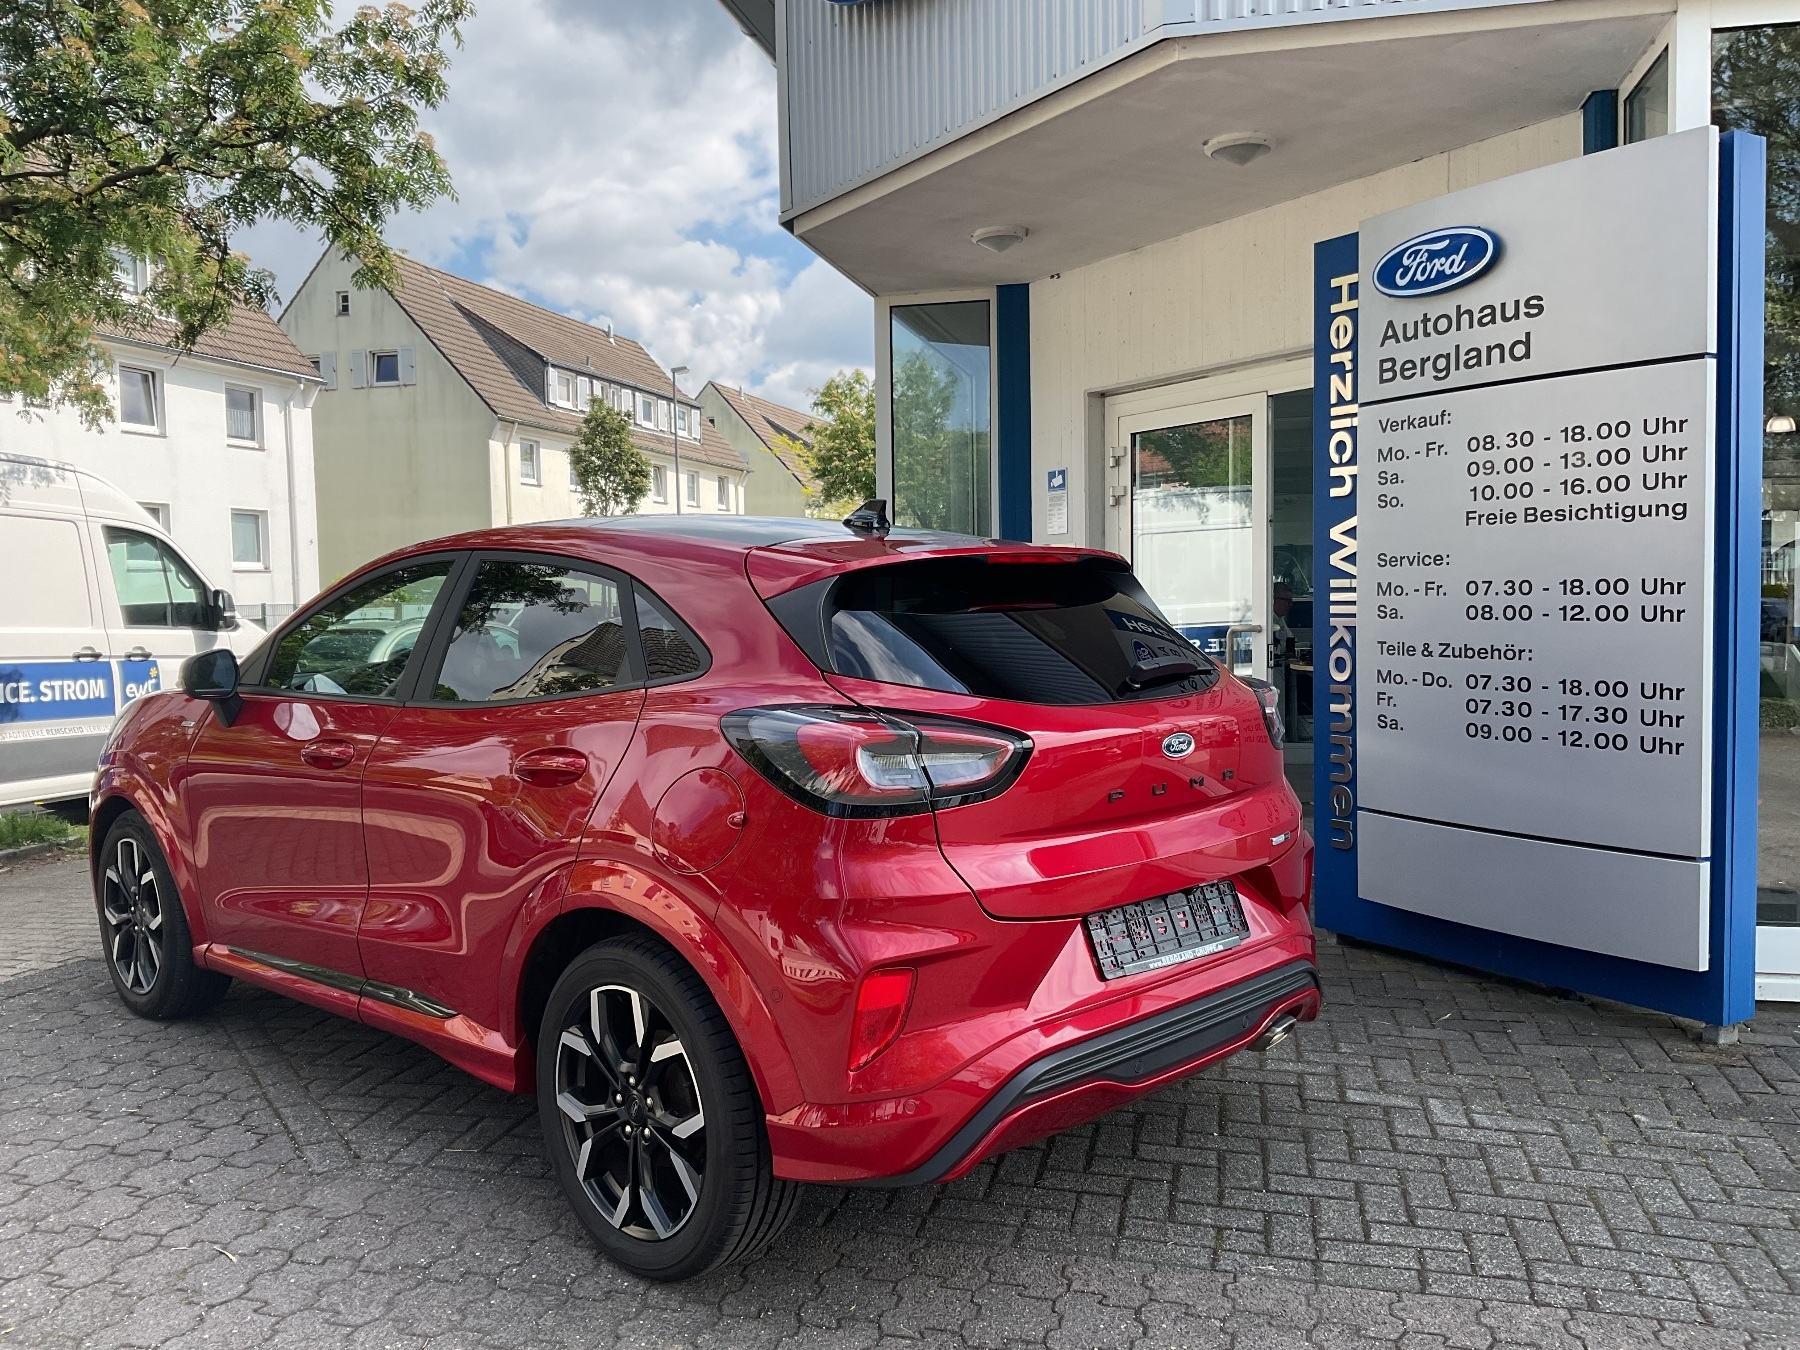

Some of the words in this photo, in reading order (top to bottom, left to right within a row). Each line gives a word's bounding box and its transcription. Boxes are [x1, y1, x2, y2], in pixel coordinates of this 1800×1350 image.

[1395, 236, 1469, 286] Ford
[1379, 295, 1545, 348] Autohaus
[1379, 331, 1532, 384] Bergland
[1329, 273, 1358, 497] Herzlich
[1379, 410, 1451, 433] Verkauf:
[1378, 447, 1409, 463] Mo.
[1426, 441, 1447, 457] Fr.
[1467, 431, 1534, 452] 08.30
[1560, 421, 1631, 443] 18.00
[1643, 417, 1688, 435] Uhr
[1378, 471, 1404, 485] Sa.
[1467, 456, 1533, 477] 09.00
[1560, 448, 1630, 469] 13.00
[1643, 445, 1688, 463] Uhr
[1378, 494, 1403, 508] So.
[1470, 482, 1533, 501] 10.00
[1560, 475, 1630, 495] 16.00
[1643, 472, 1687, 490] Uhr
[1466, 509, 1517, 526] Freie
[1524, 502, 1687, 523] Besichtigung
[1377, 552, 1449, 567] Service:
[1377, 582, 1408, 596] Mo.
[1425, 581, 1446, 596] Fr.
[1466, 580, 1532, 596] 07.30
[1559, 578, 1629, 595] 18.00
[1641, 578, 1686, 595] Uhr
[1377, 605, 1403, 619] Sa.
[1466, 605, 1532, 621] 08.00
[1559, 605, 1628, 622] 12.00
[1641, 605, 1685, 622] Uhr
[1377, 641, 1416, 656] Teile
[1421, 643, 1434, 657] &
[1438, 643, 1532, 661] Zubehör:
[39, 679, 105, 703] STROM
[1328, 515, 1357, 849] Willkommen
[1377, 669, 1407, 685] Mo.
[1423, 672, 1452, 688] Do.
[1466, 674, 1531, 692] 07.30
[1558, 679, 1628, 698] 18.00
[1641, 682, 1685, 700] Uhr
[1377, 692, 1396, 707] Fr.
[1466, 698, 1532, 718] 07.30
[1558, 705, 1627, 724] 17.30
[1641, 709, 1685, 728] Uhr
[1378, 714, 1403, 731] Sa.
[1466, 723, 1532, 743] 09.00
[1558, 730, 1628, 751] 12.00
[1640, 736, 1684, 755] Uhr
